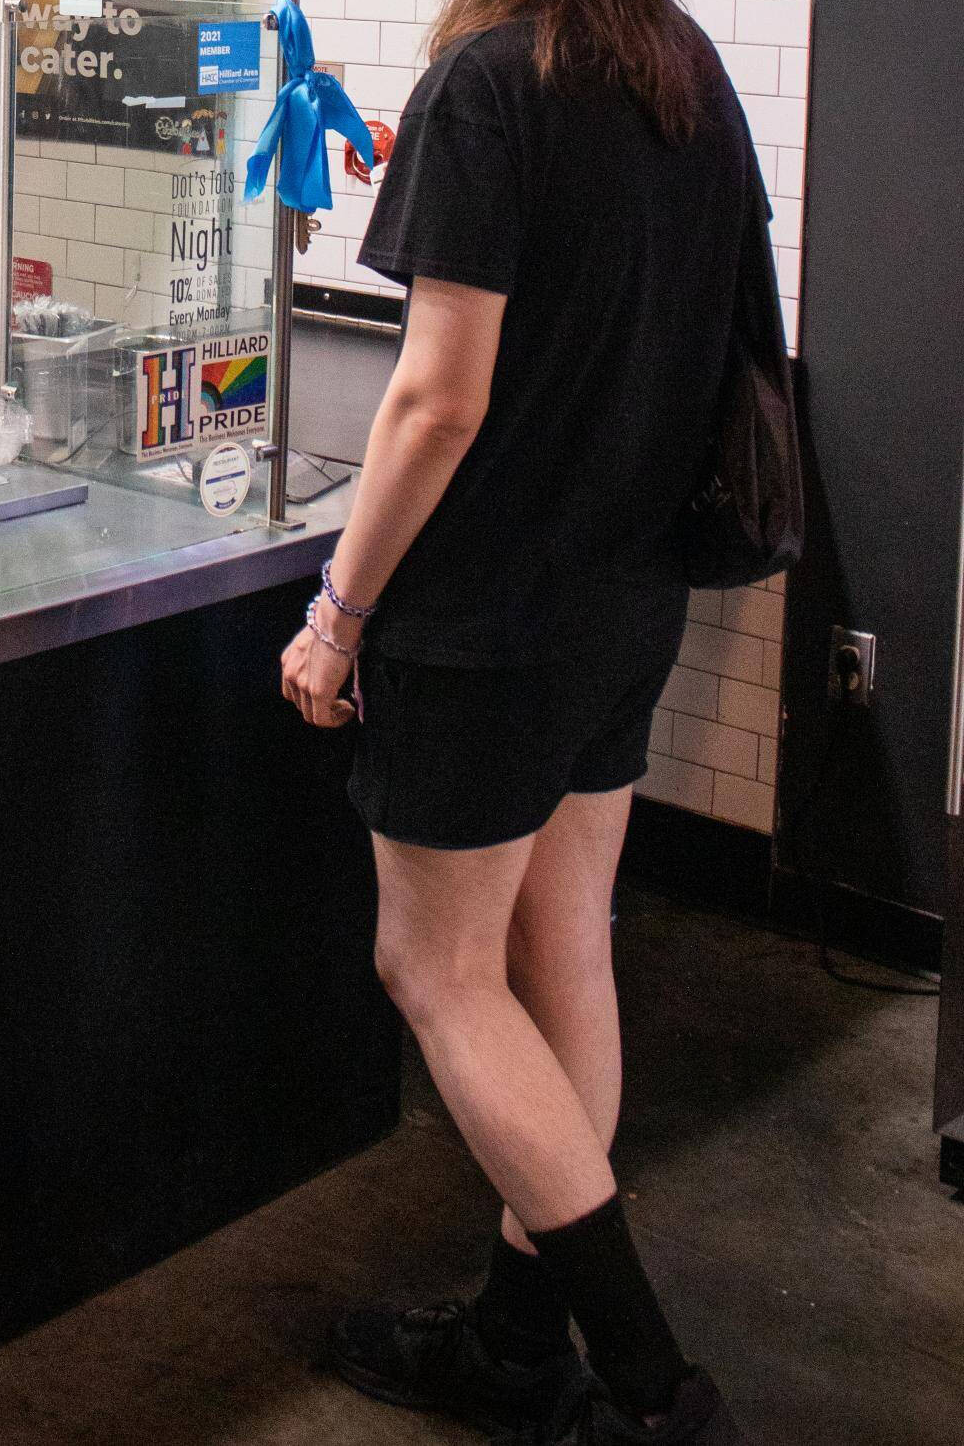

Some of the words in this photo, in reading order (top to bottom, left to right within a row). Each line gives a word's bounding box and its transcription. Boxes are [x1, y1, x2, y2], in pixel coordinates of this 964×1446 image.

[107, 1, 143, 36] to
[200, 31, 221, 42] 2021
[20, 45, 124, 80] cater.
[199, 46, 231, 56] MEMBER
[219, 68, 242, 78] Hilliard
[243, 68, 259, 77] Area
[172, 172, 206, 200] Dot's
[210, 170, 235, 195] Tots
[172, 198, 233, 218] FOUNDATION
[171, 217, 233, 271] Night
[169, 277, 193, 304] 10%
[196, 276, 206, 288] OF
[169, 311, 194, 328] Every
[196, 305, 231, 323] Monday
[202, 335, 269, 360] HILLIARD
[200, 405, 266, 433] PRIDE
[199, 434, 208, 443] This
